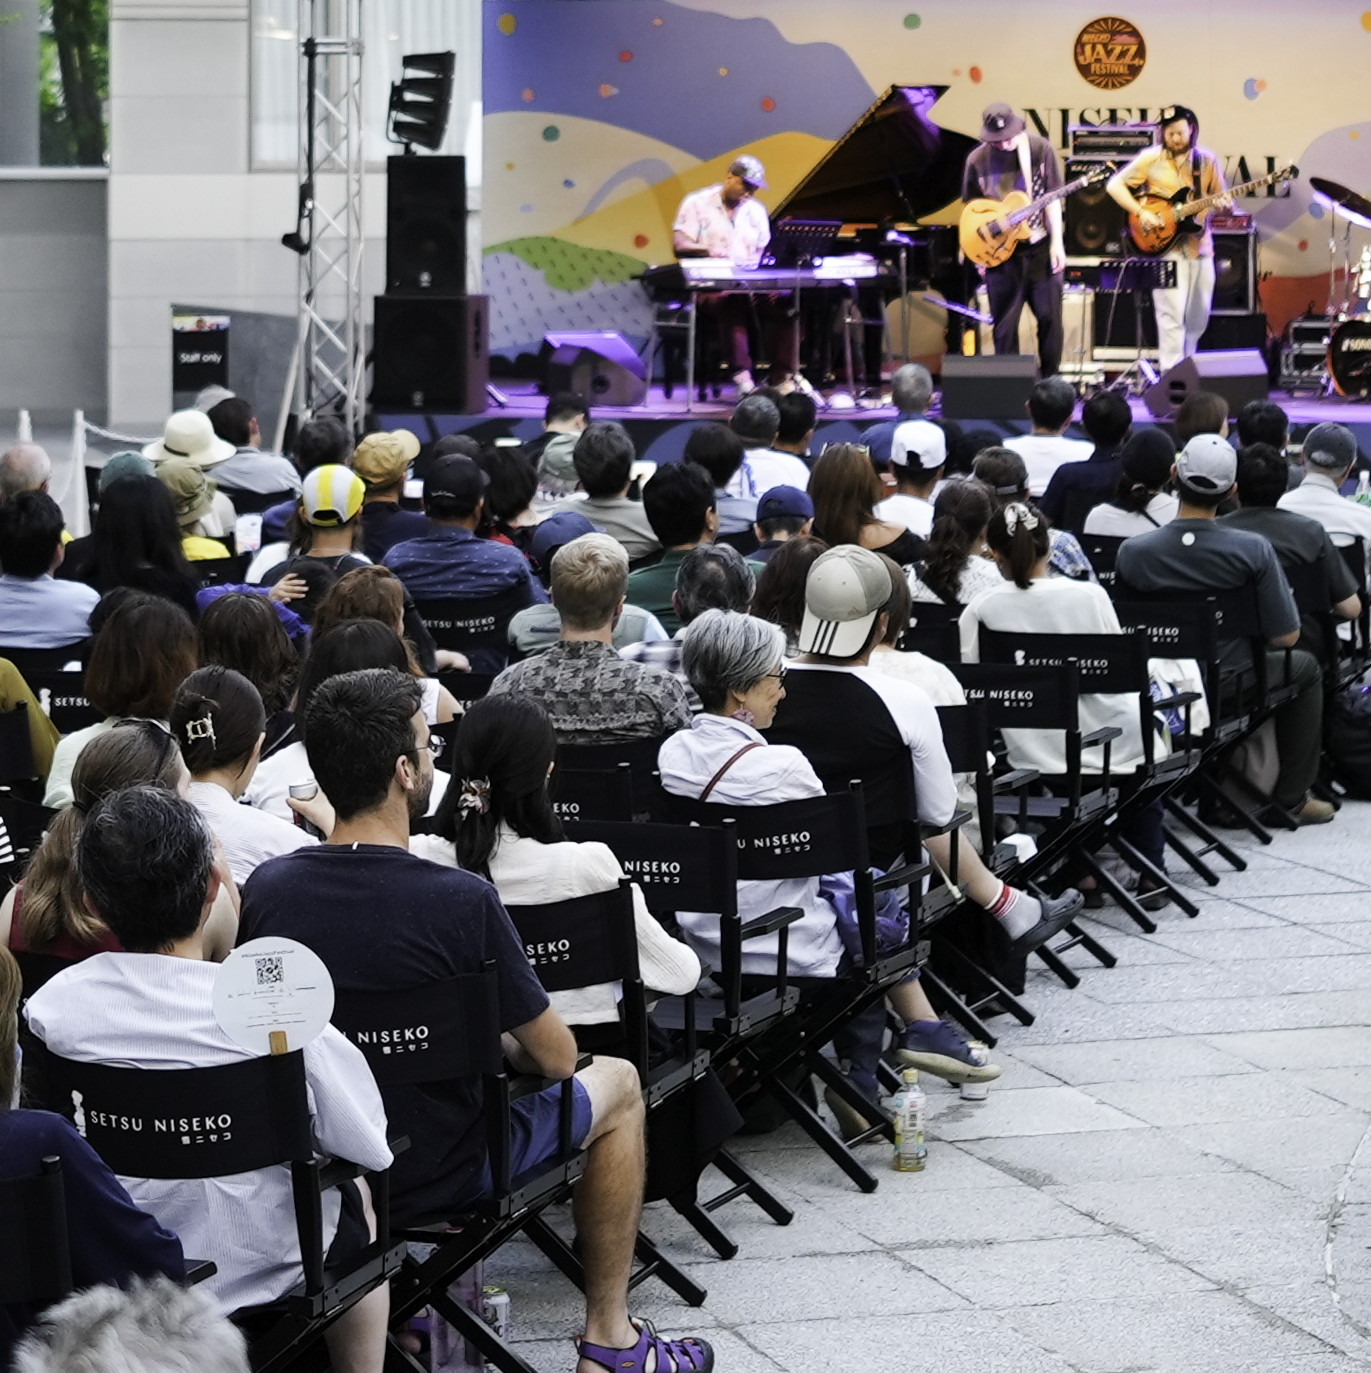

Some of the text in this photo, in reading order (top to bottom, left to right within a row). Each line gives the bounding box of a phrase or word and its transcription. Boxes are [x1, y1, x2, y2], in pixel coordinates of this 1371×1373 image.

[1090, 63, 1130, 76] FESTIVAL
[180, 351, 223, 364] Staff only
[456, 616, 495, 628] NISEKO
[1146, 626, 1180, 637] ISEKO
[1076, 658, 1109, 669] SEKO
[989, 690, 1034, 701] NISEKO
[553, 802, 580, 814] EKO
[753, 830, 812, 849] NISEKO
[624, 860, 681, 875] NISEKO
[526, 938, 571, 957] SEKO
[357, 1025, 430, 1045] NISEKO
[90, 1110, 232, 1133] SETSU NISEKO
